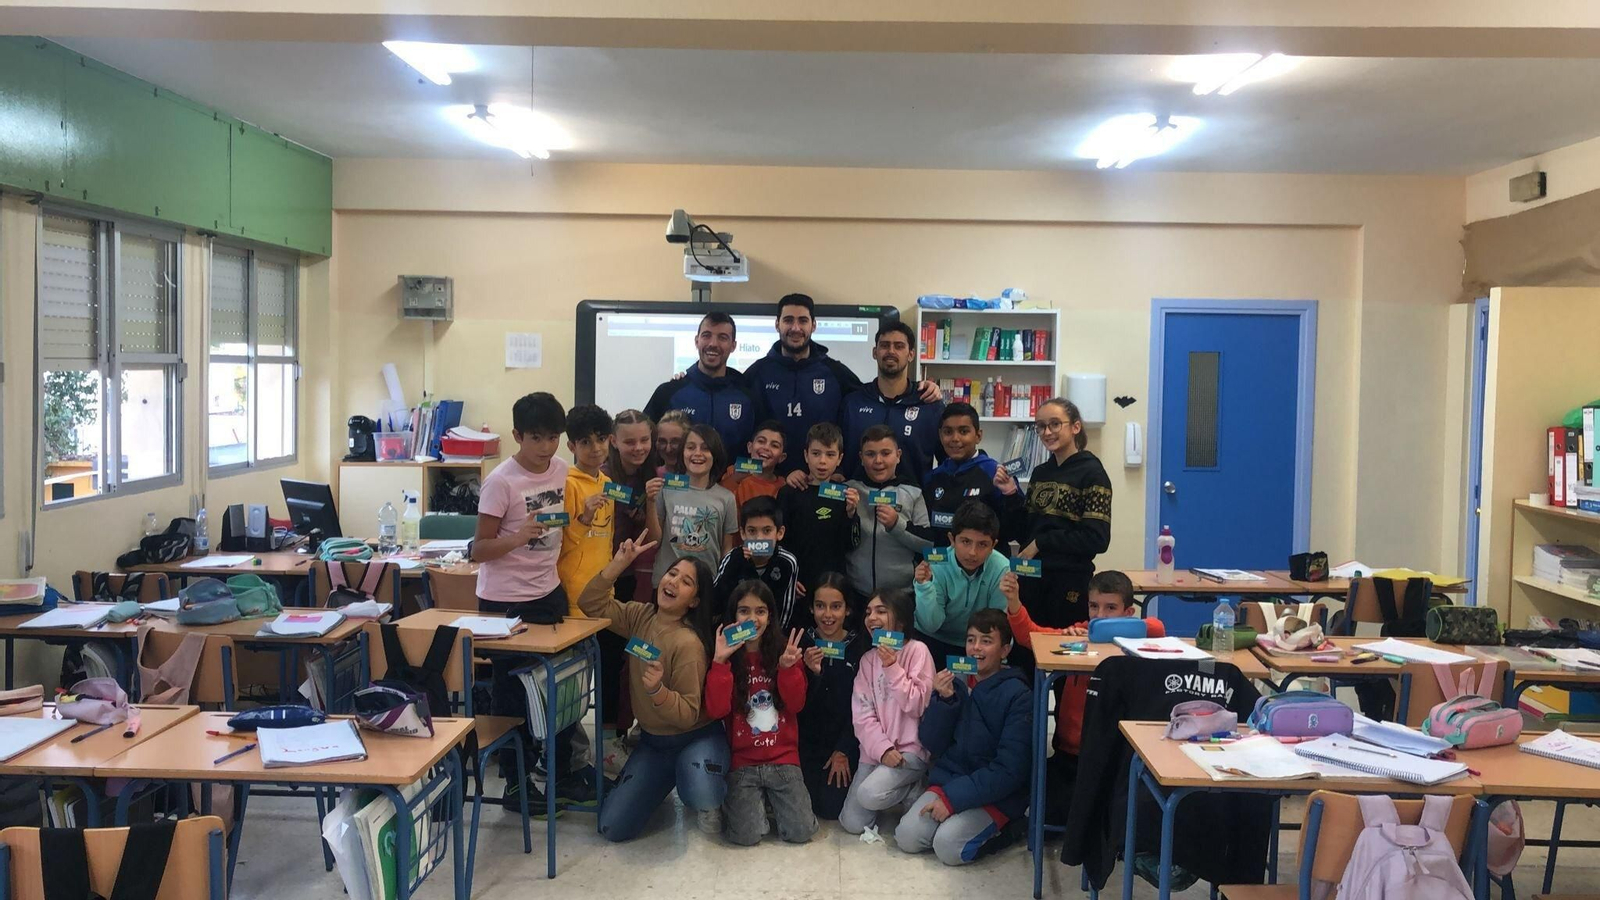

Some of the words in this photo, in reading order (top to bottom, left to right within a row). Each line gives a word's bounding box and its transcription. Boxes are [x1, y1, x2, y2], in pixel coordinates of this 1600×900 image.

[739, 343, 760, 352] Hiato
[787, 403, 802, 416] 14
[904, 425, 912, 436] 9
[674, 504, 697, 516] PALM
[747, 541, 769, 550] NOP
[1165, 688, 1206, 697] FACTORY
